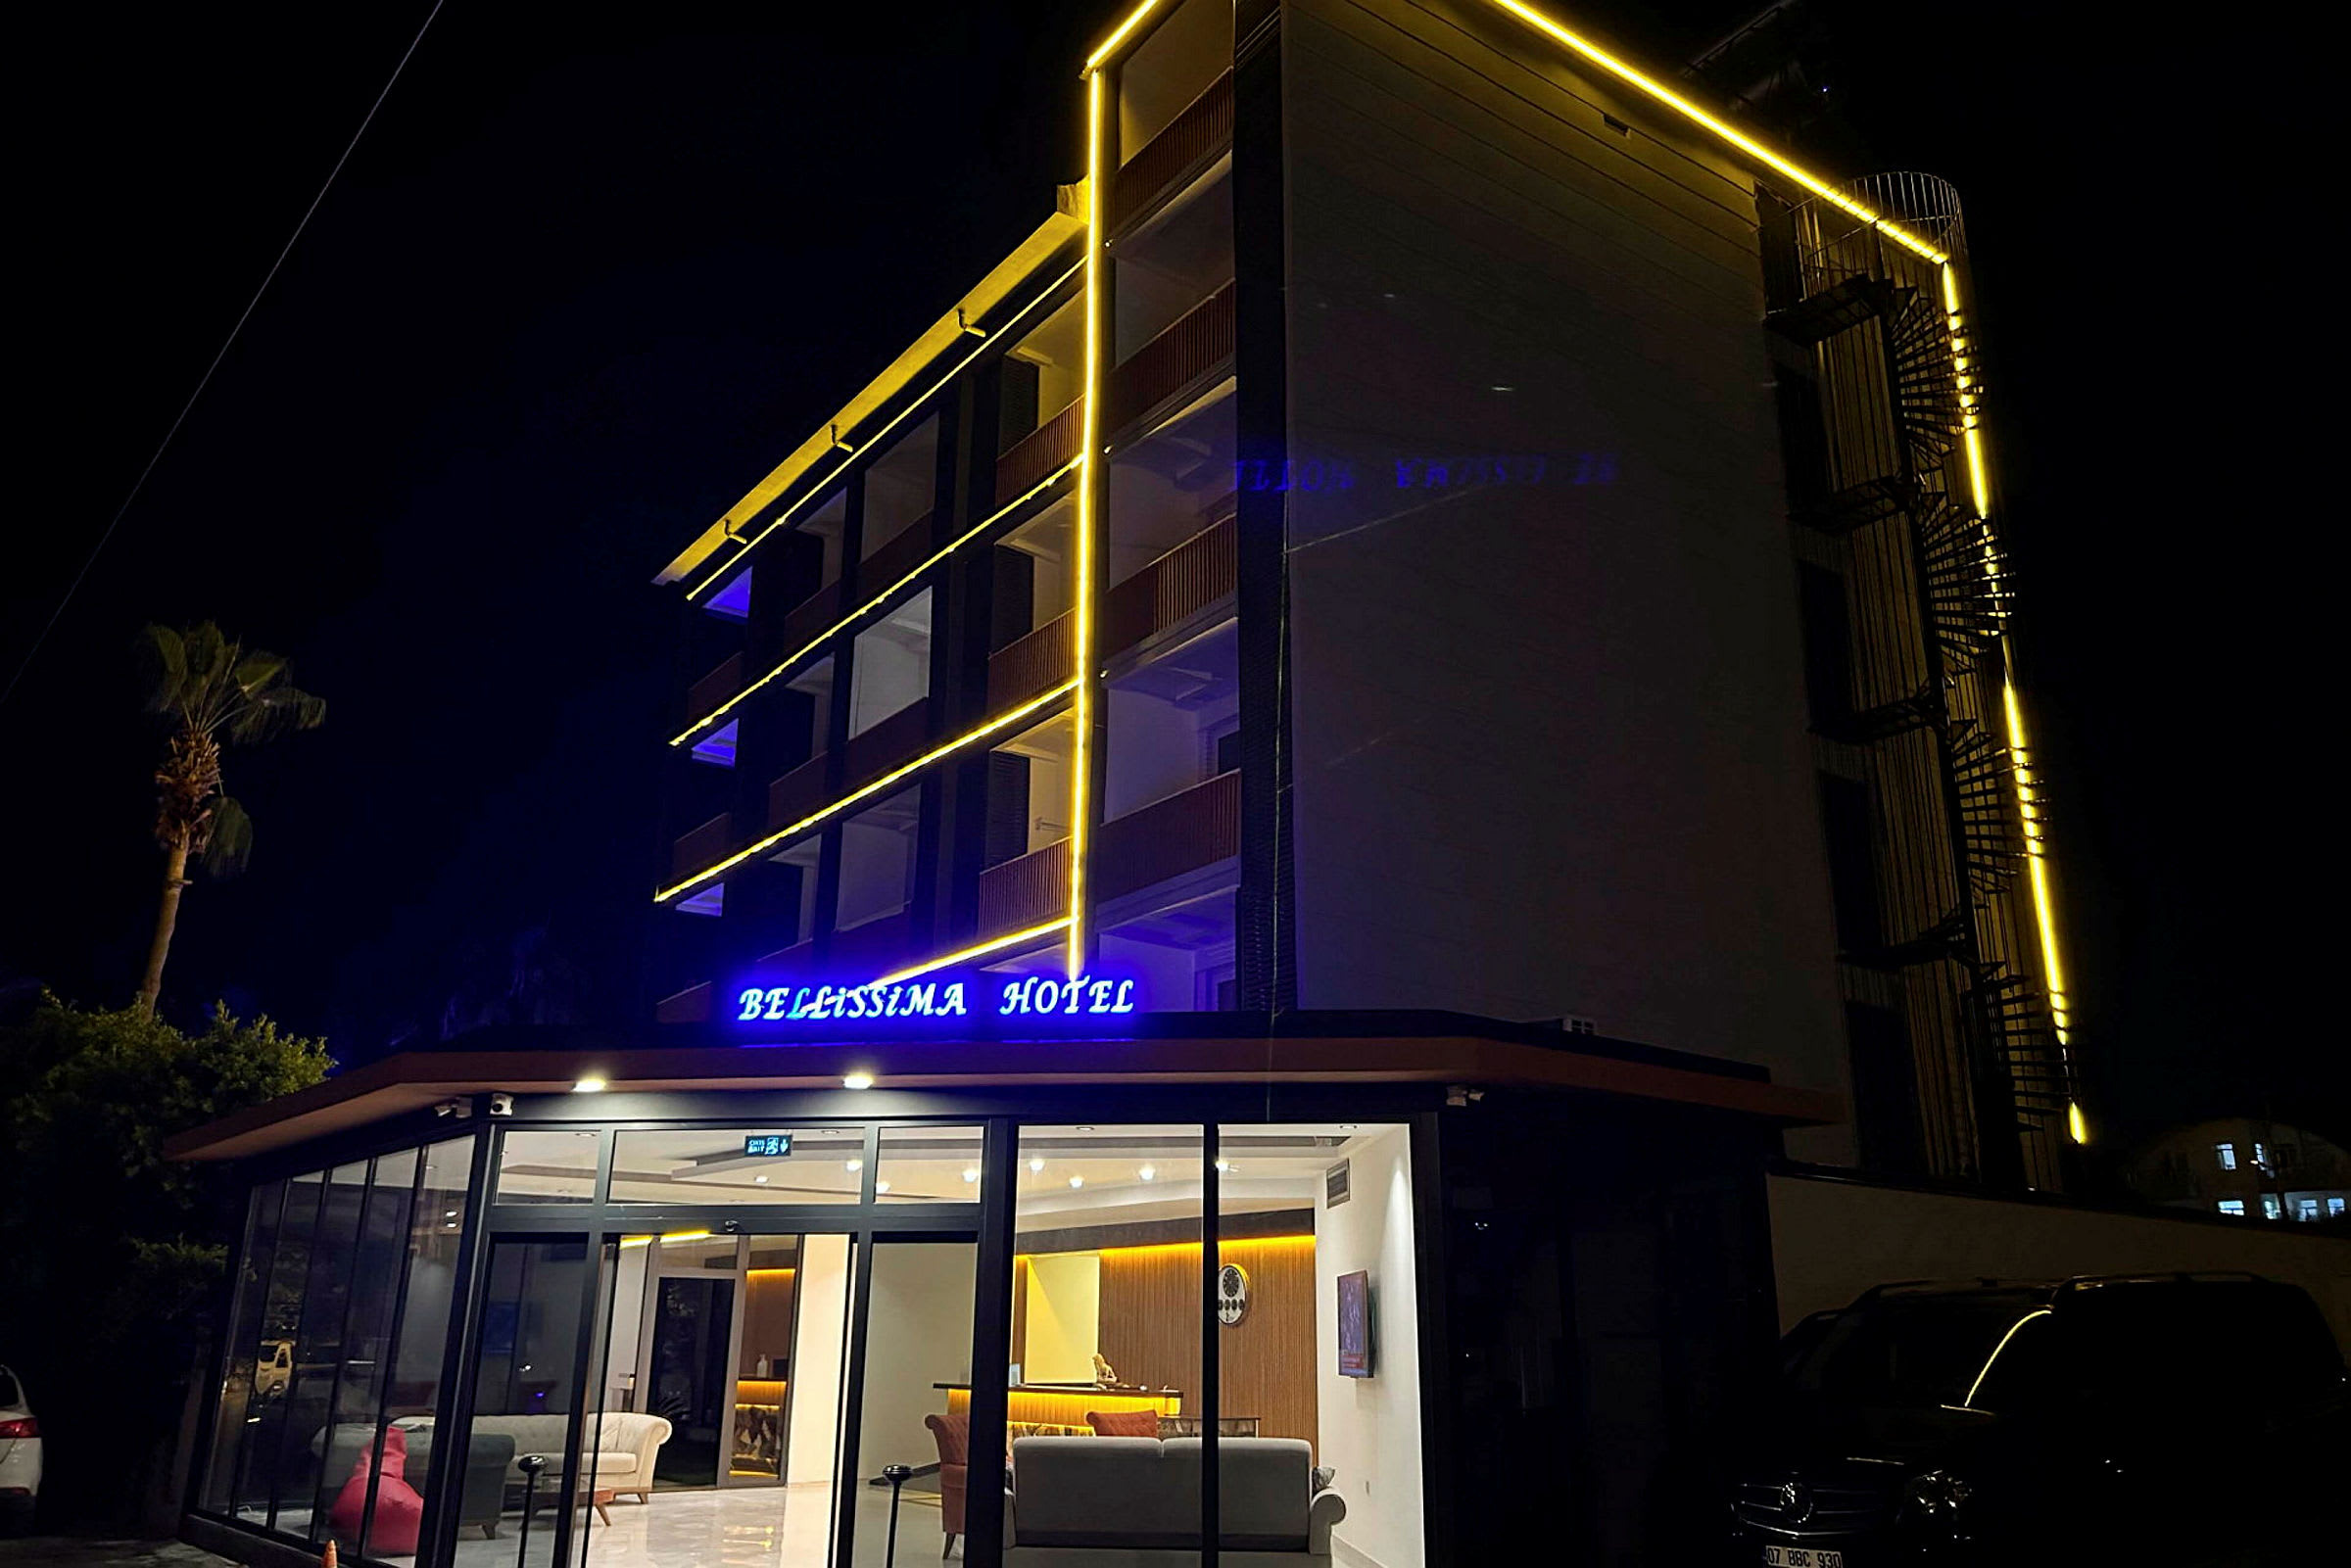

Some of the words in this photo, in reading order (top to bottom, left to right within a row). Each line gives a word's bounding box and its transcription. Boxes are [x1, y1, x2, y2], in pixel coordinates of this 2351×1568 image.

[998, 974, 1135, 1016] HOTEL
[1767, 1547, 1781, 1564] 07
[1788, 1549, 1811, 1567] BBC
[1817, 1551, 1842, 1568] 930
